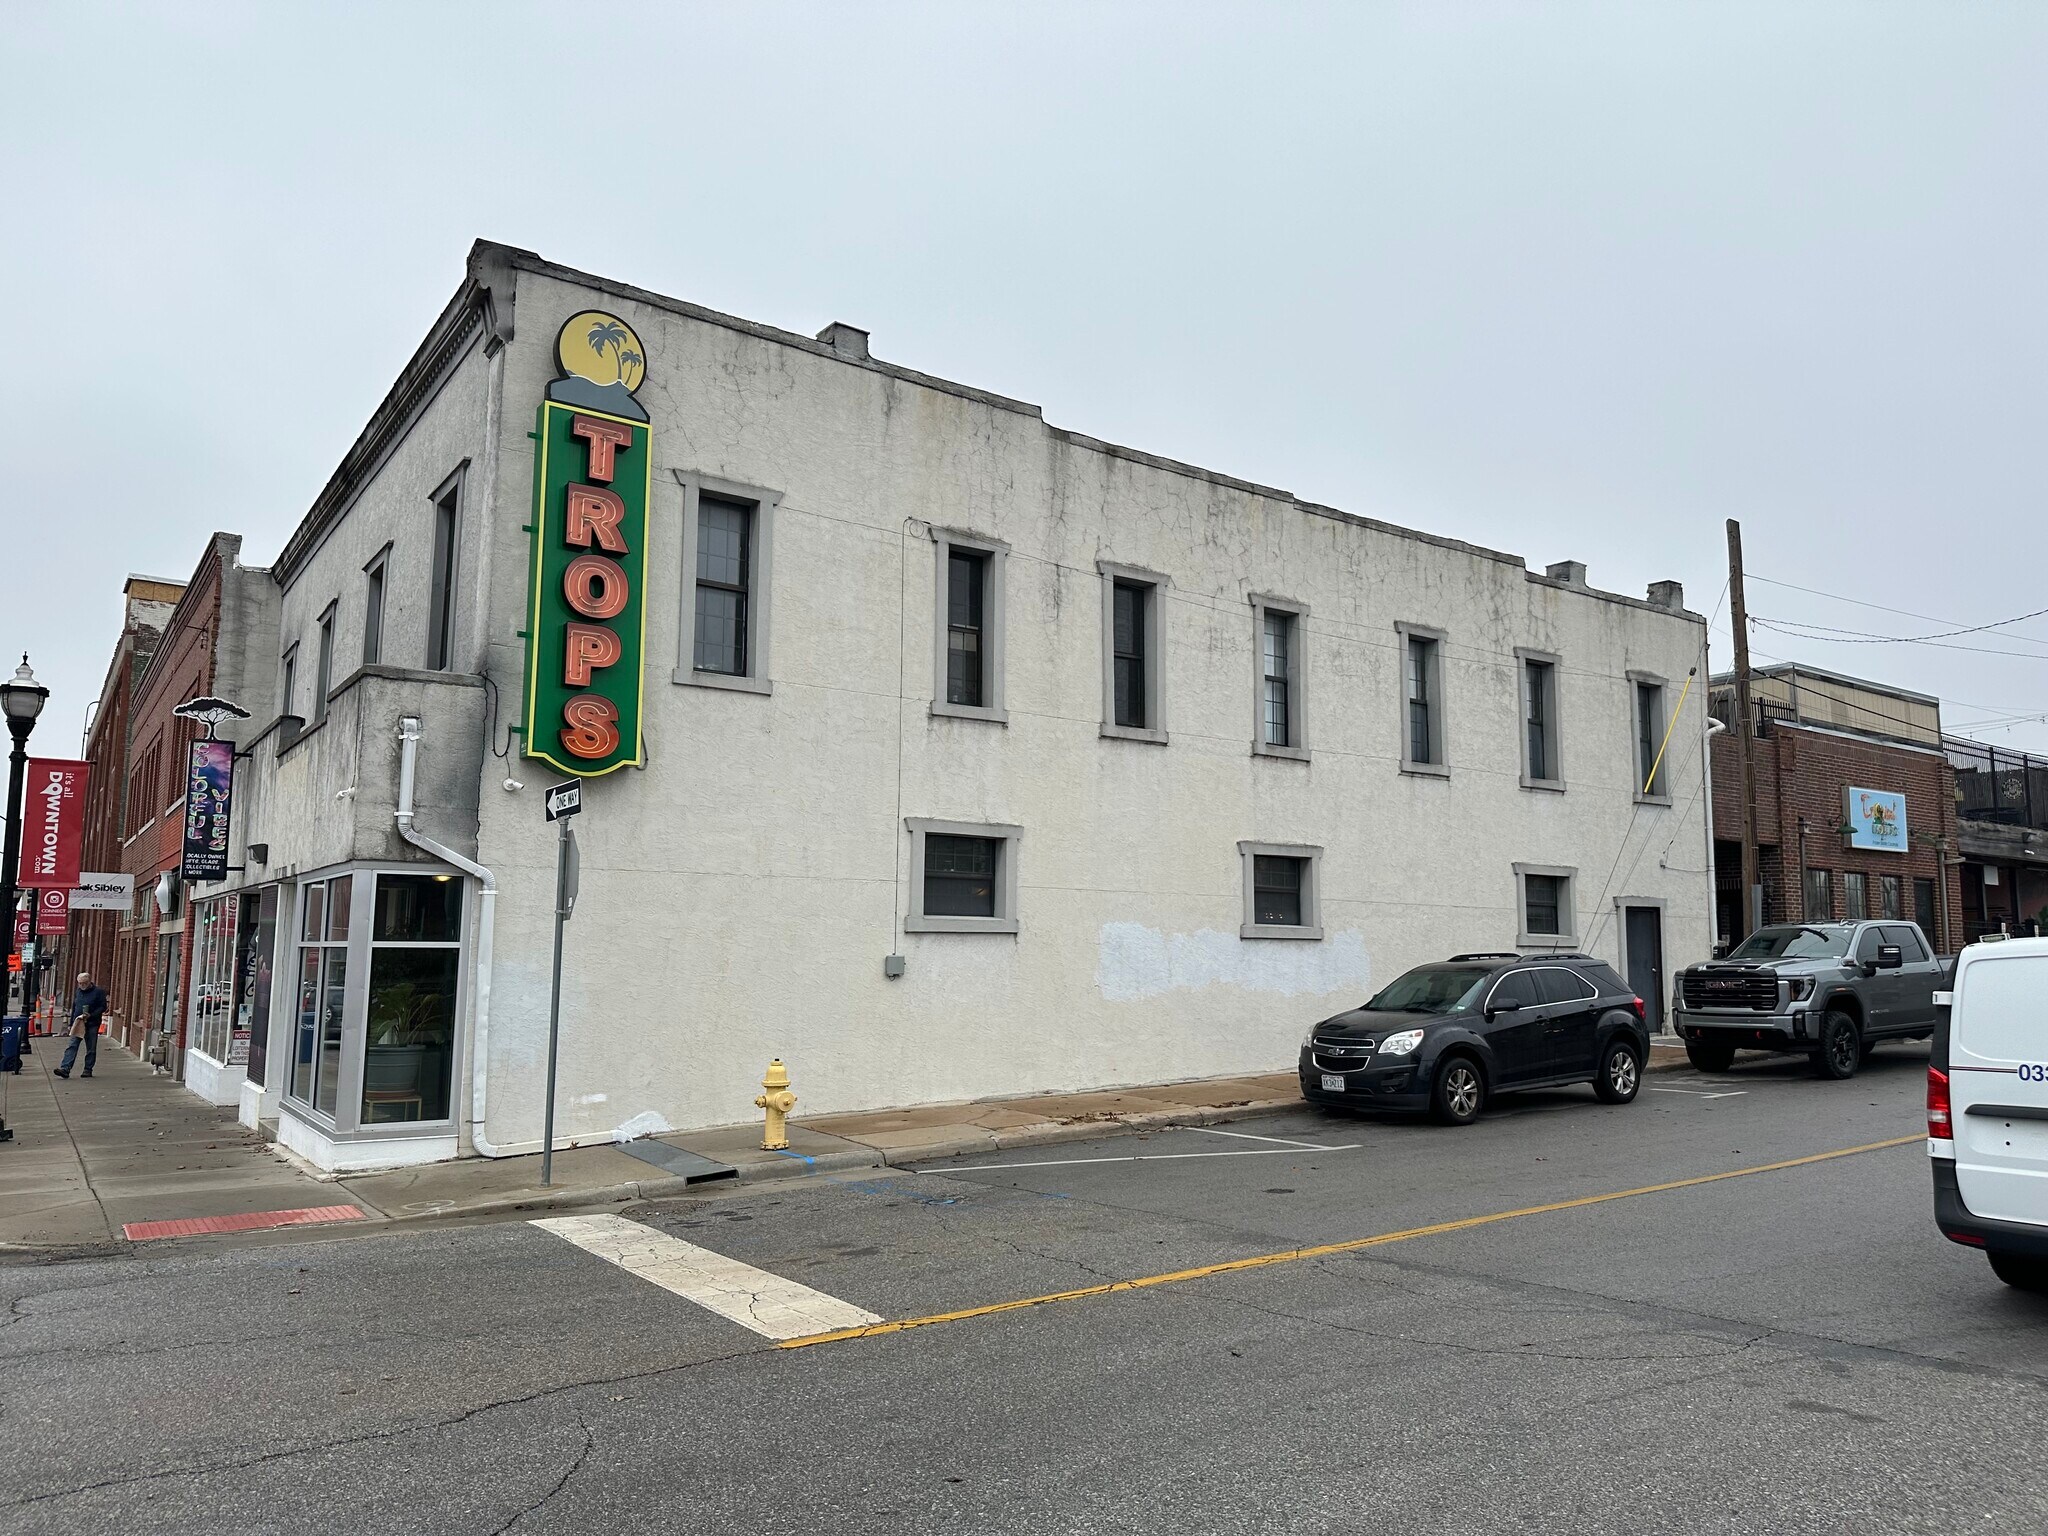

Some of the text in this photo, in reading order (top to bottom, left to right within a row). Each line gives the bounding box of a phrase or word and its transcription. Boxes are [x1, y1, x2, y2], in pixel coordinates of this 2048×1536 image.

[560, 413, 634, 760] TROPS
[63, 772, 75, 798] it's all
[556, 790, 578, 809] ONE WAY
[40, 771, 63, 874] DOWNTOWN
[208, 788, 230, 851] VIBES
[94, 884, 126, 894] Sibley
[2018, 1064, 2048, 1082] 03
